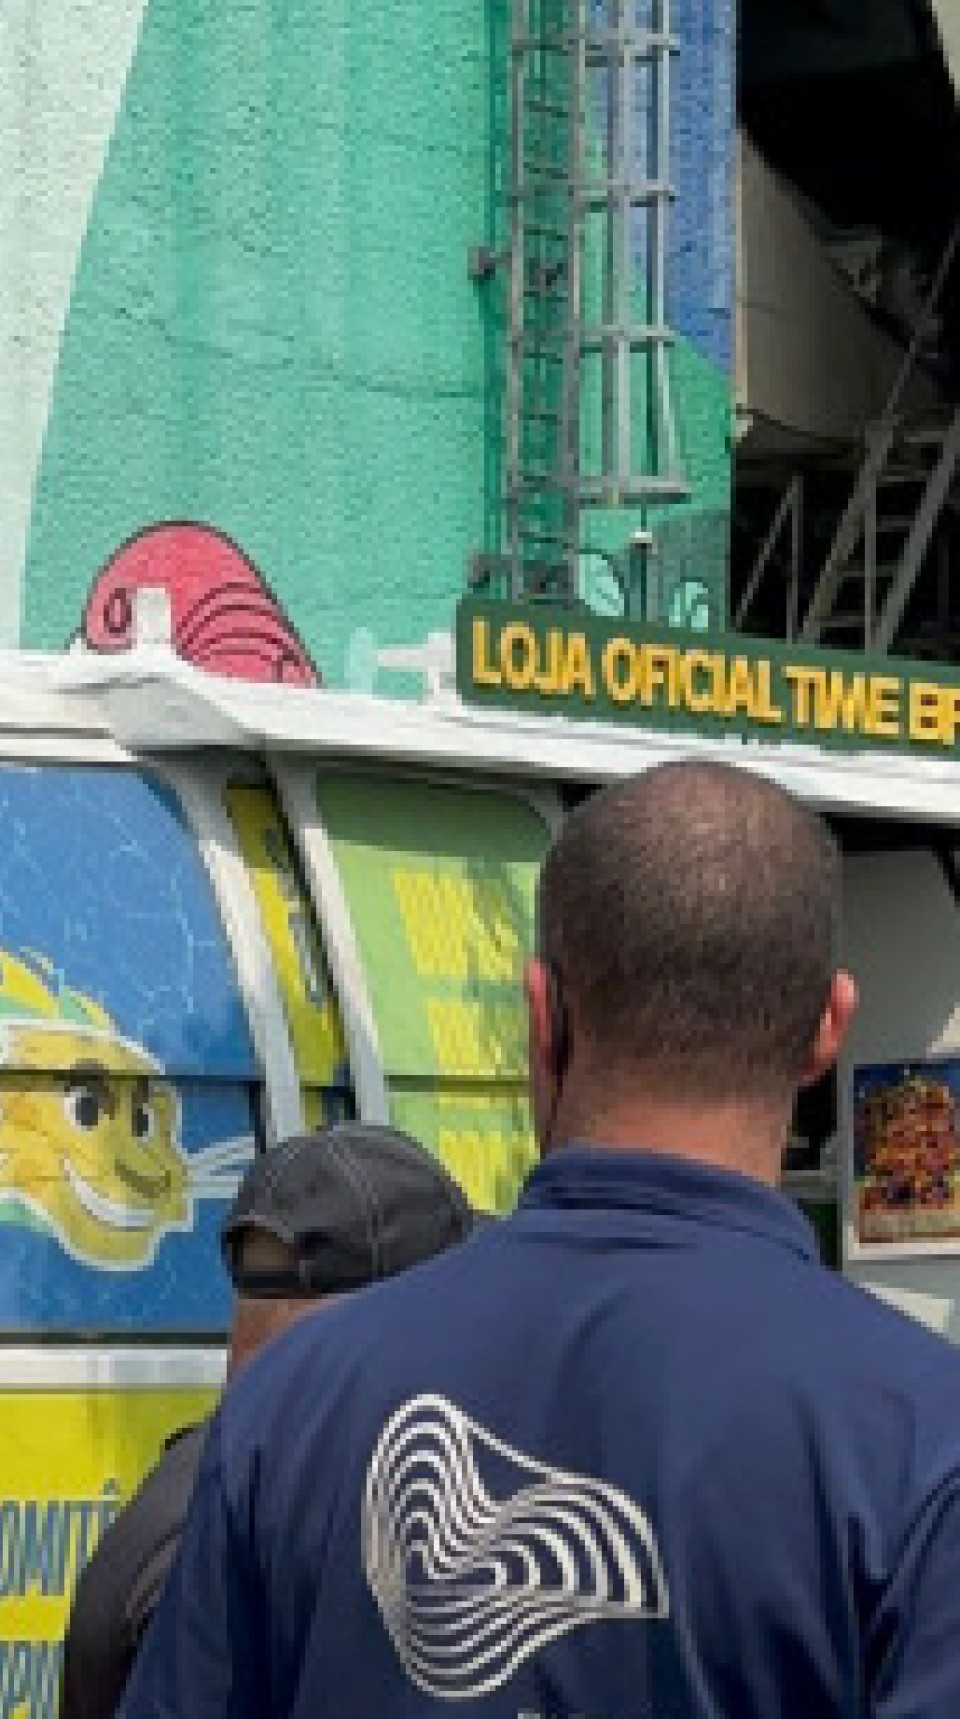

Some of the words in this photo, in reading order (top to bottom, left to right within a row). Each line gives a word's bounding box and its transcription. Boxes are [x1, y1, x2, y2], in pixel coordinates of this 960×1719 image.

[470, 616, 596, 696] LOJA
[603, 637, 782, 725] OFICIAL
[785, 665, 900, 736] TIME
